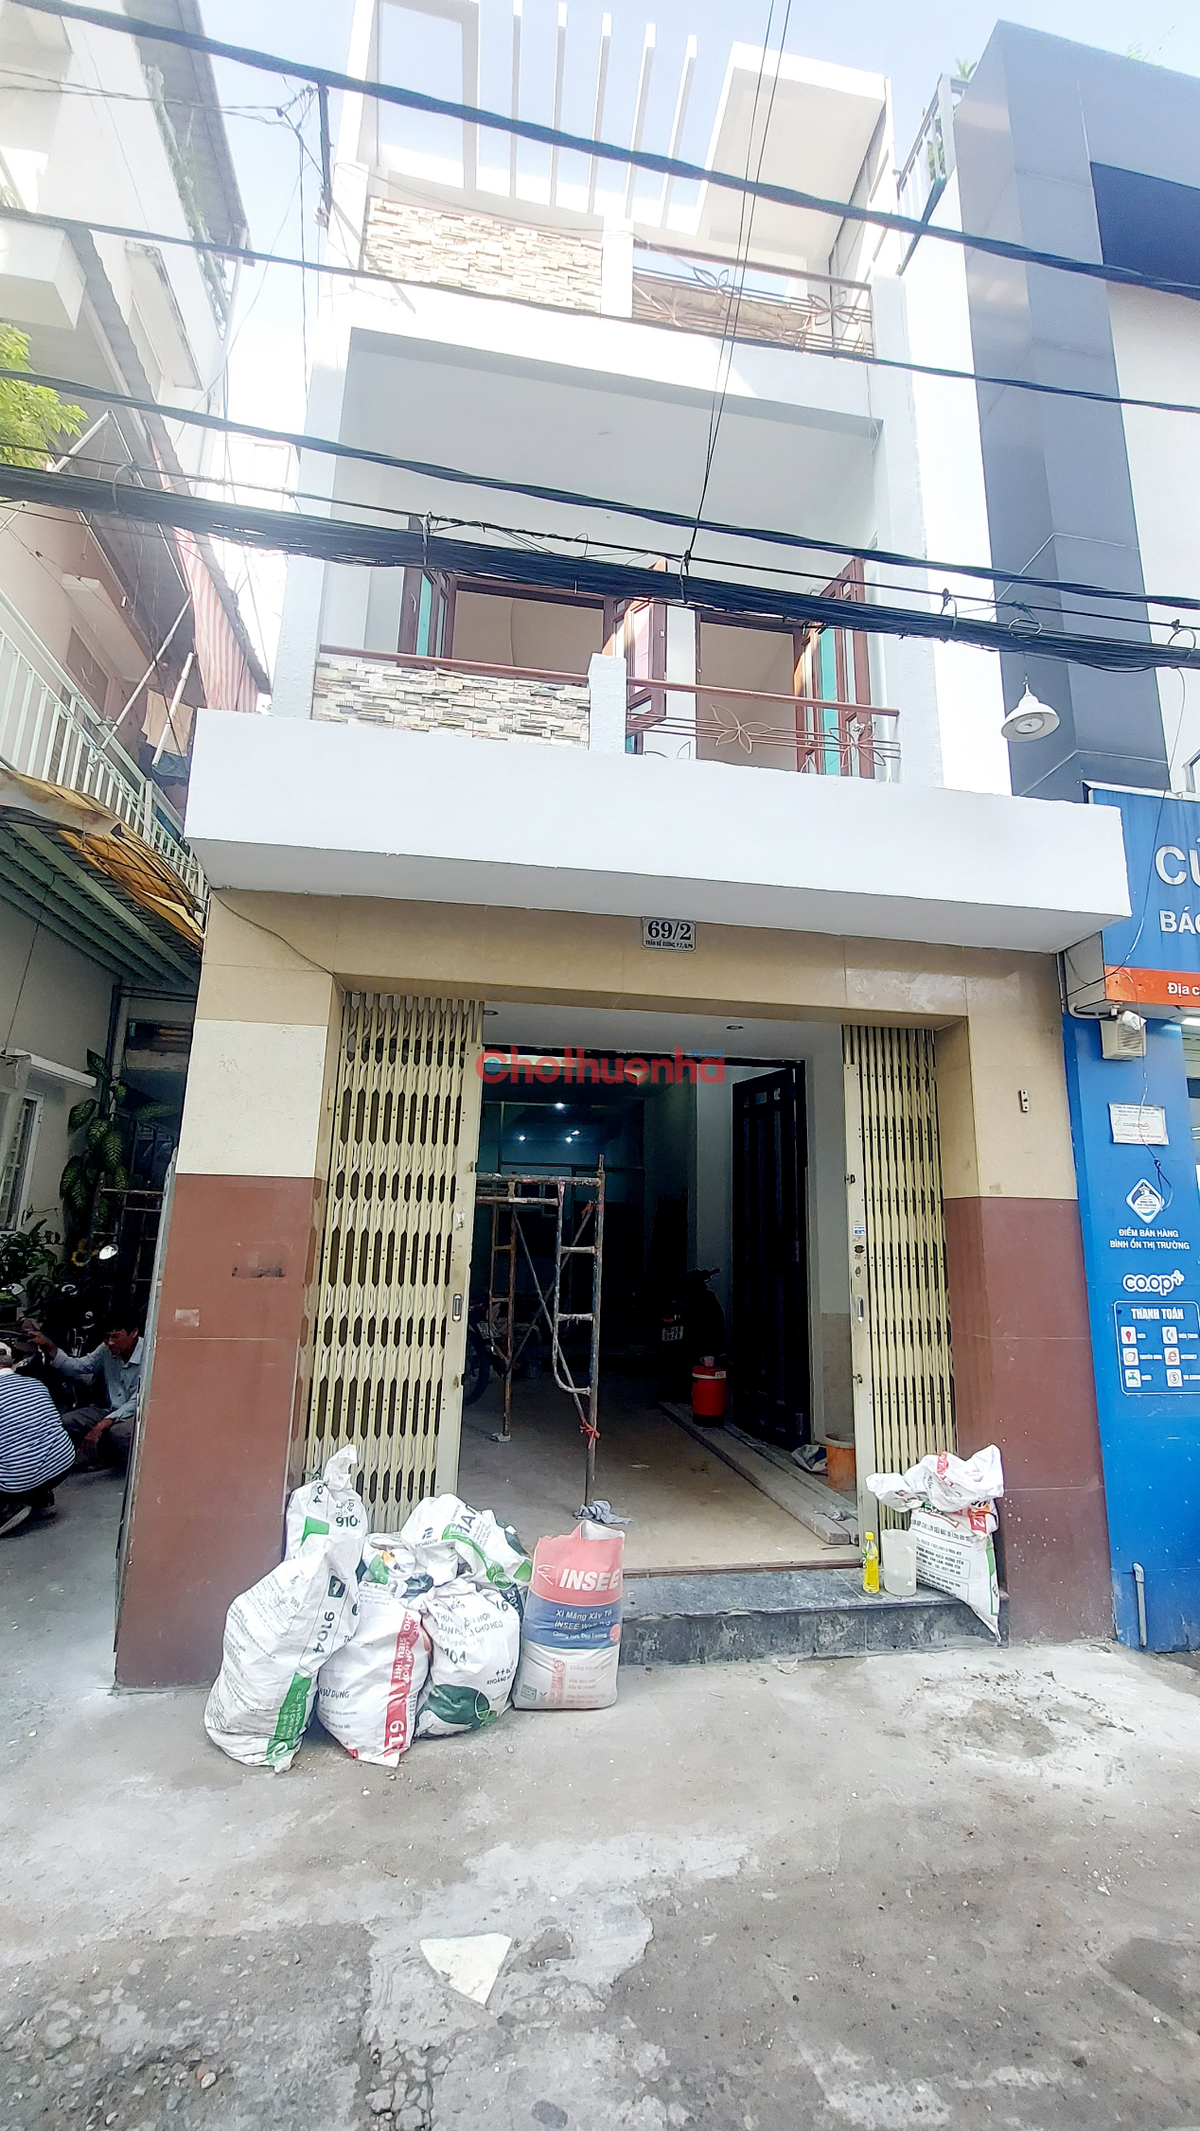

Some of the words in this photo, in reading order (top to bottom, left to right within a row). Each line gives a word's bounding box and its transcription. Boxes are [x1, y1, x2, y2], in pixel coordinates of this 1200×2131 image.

[648, 920, 692, 940] 69/2
[1167, 982, 1190, 997] Địa
[1118, 1226, 1138, 1237] ĐIỂM
[1140, 1228, 1156, 1237] BÁN
[1156, 1228, 1179, 1238] HÀNG
[1110, 1239, 1128, 1248] BÌNH
[1142, 1241, 1156, 1250] THỊ
[1156, 1241, 1190, 1250] TRƯỜNG
[1130, 1308, 1160, 1320] THANH
[1160, 1307, 1184, 1320] TOÁN
[336, 1514, 361, 1527] 910
[559, 1568, 621, 1592] INSEE
[554, 1621, 580, 1630] INSEE
[313, 1611, 335, 1655] 9104
